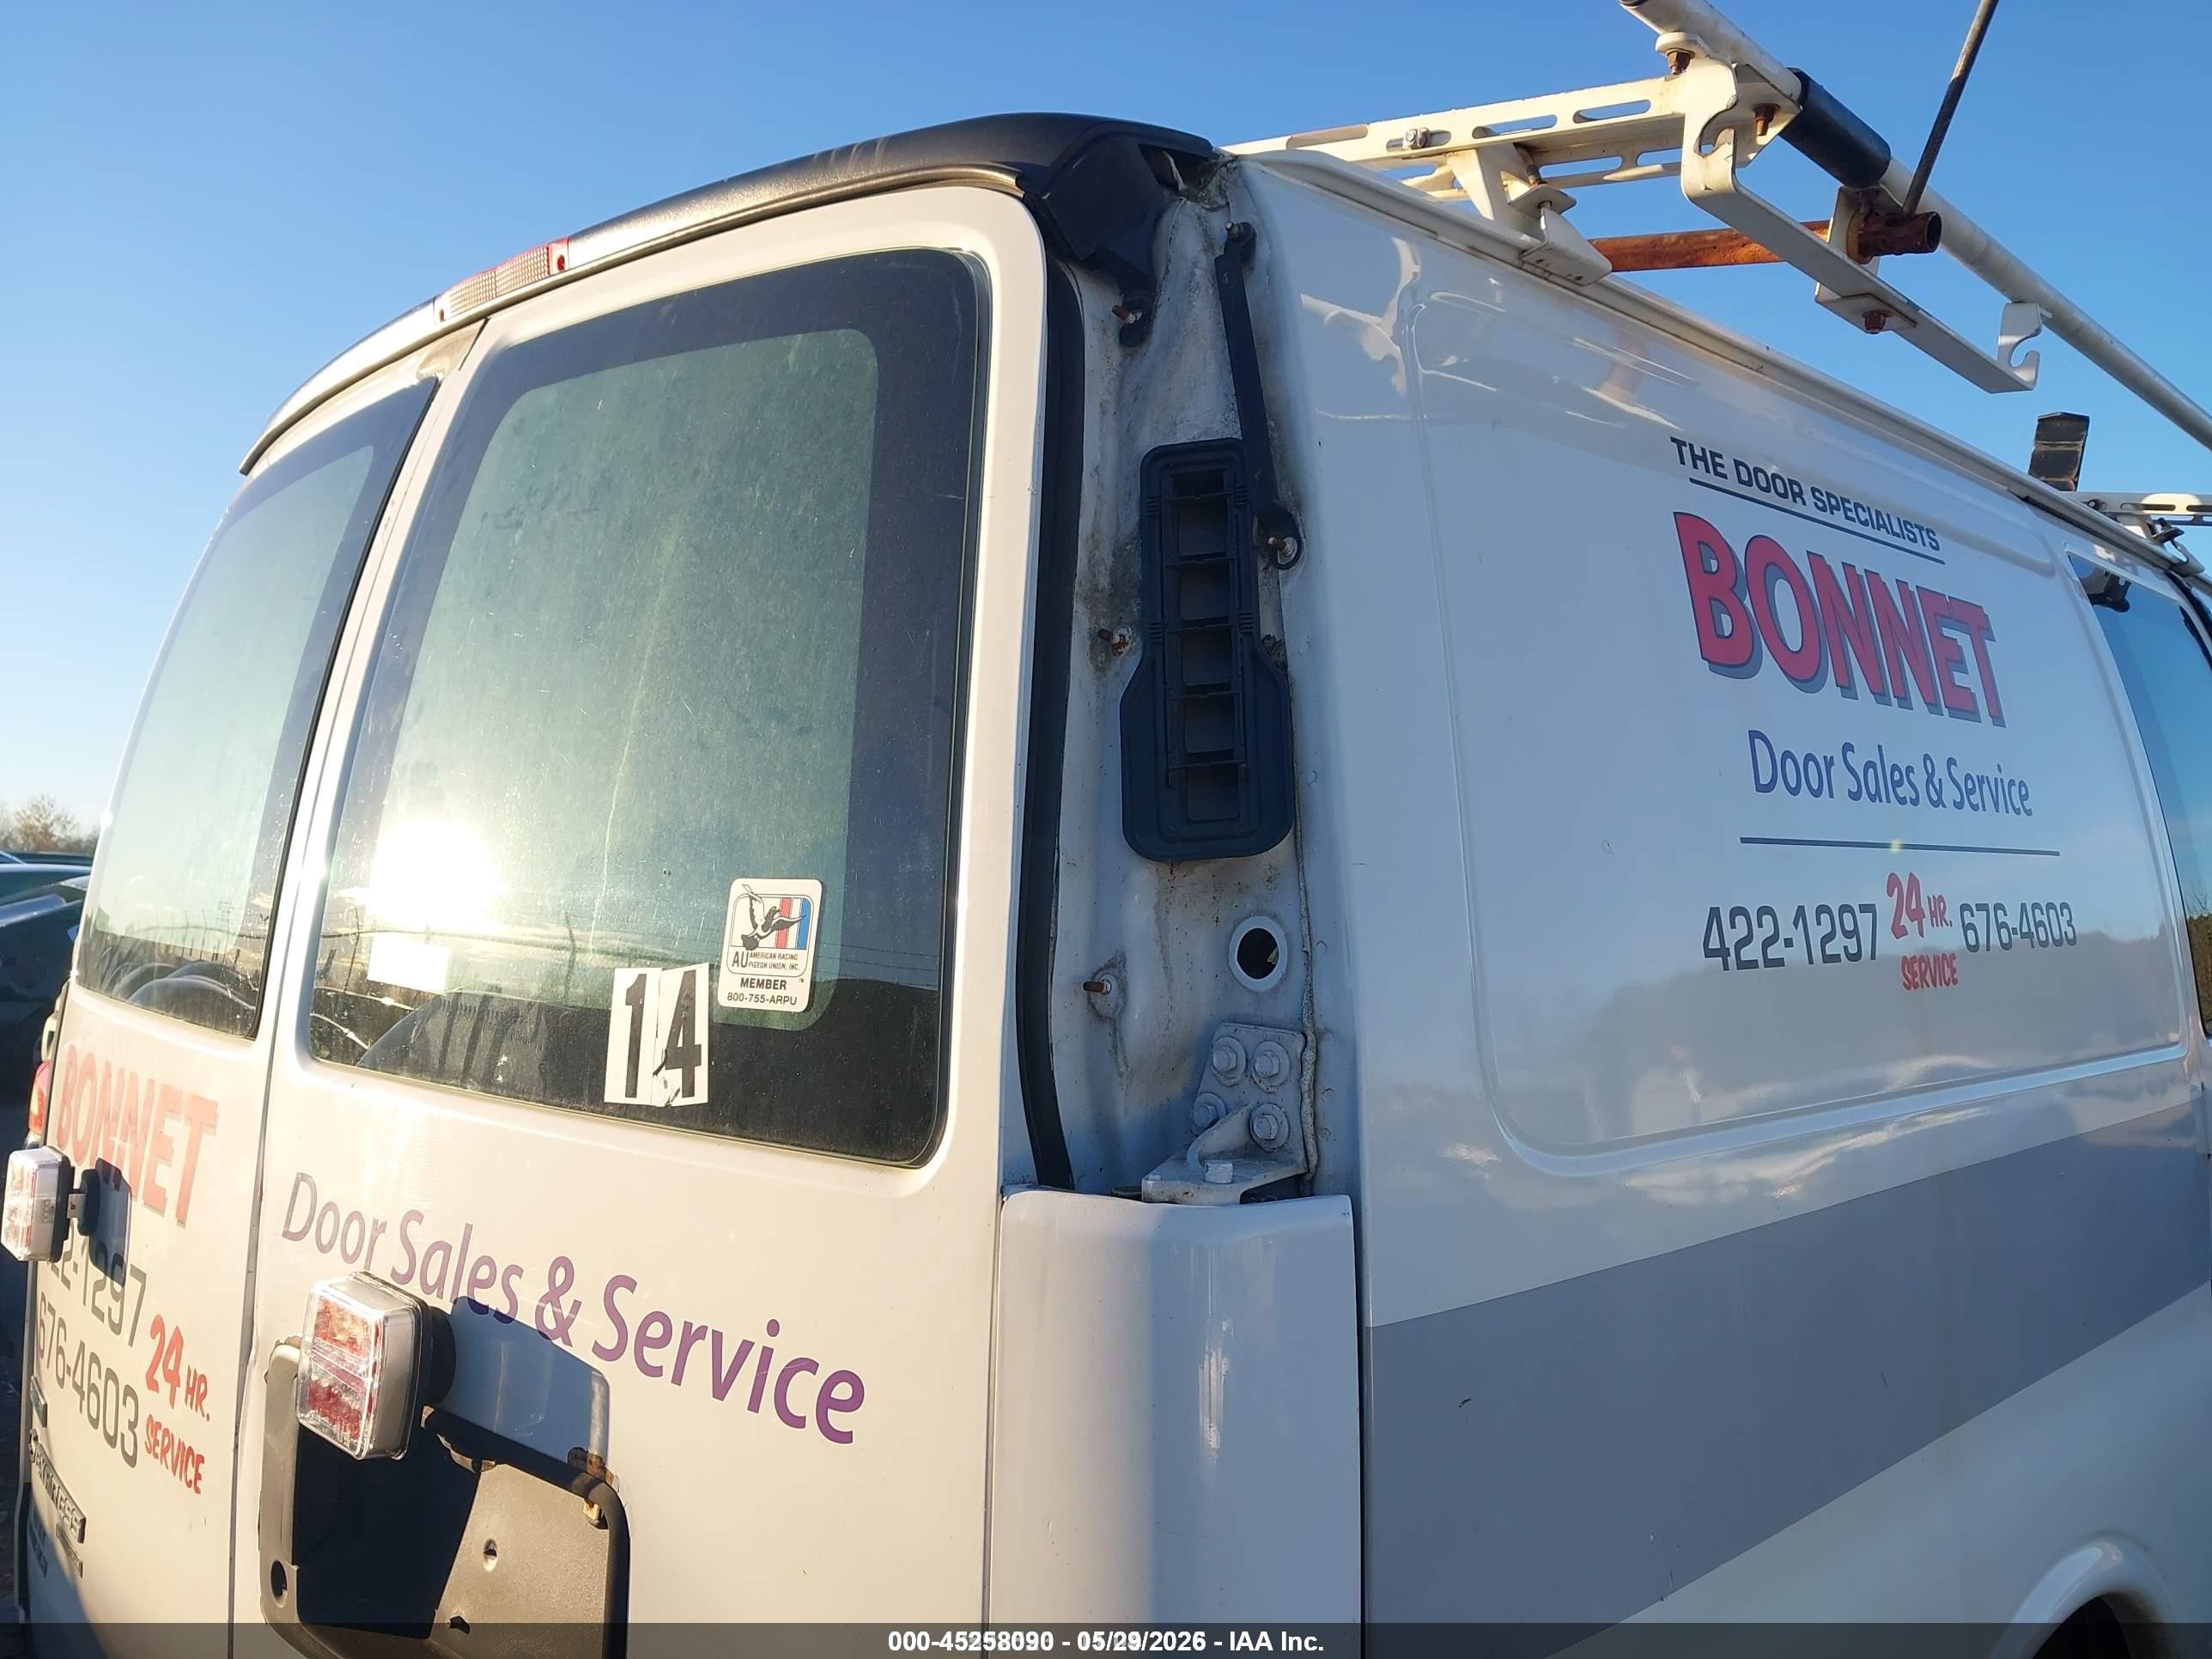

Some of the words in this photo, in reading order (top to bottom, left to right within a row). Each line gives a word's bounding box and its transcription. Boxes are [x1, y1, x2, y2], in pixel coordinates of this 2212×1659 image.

[1670, 436, 1729, 480] THE
[1733, 459, 1807, 506] DOOR
[1810, 485, 1941, 552] SPECIALISTS
[1674, 511, 2006, 728] BONNET
[1747, 729, 1835, 799] Door
[1841, 742, 1920, 808] Sales
[1923, 753, 1947, 809] &
[1946, 757, 2033, 817] Service
[1703, 903, 1877, 972] 422-1297
[1887, 872, 1926, 940] 24
[1927, 894, 1954, 928] HR.
[1959, 902, 2078, 954] 676-4603
[732, 951, 749, 968] AU
[740, 977, 787, 991] MEMBER
[748, 961, 768, 969] PIGEON
[788, 963, 800, 971] INC.
[749, 951, 777, 960] AMERICAN
[1901, 953, 1959, 991] SERVICE
[726, 992, 798, 1006] 800-755-ARPU
[57, 1043, 219, 1229] BONNET
[282, 1171, 387, 1272] Door
[390, 1209, 525, 1325] Sales
[533, 1255, 583, 1347] &
[591, 1274, 866, 1445] Service
[37, 1291, 139, 1469] 676-4603
[145, 1314, 185, 1411] 24
[185, 1364, 210, 1422] HR.
[144, 1413, 205, 1496] SERVICE
